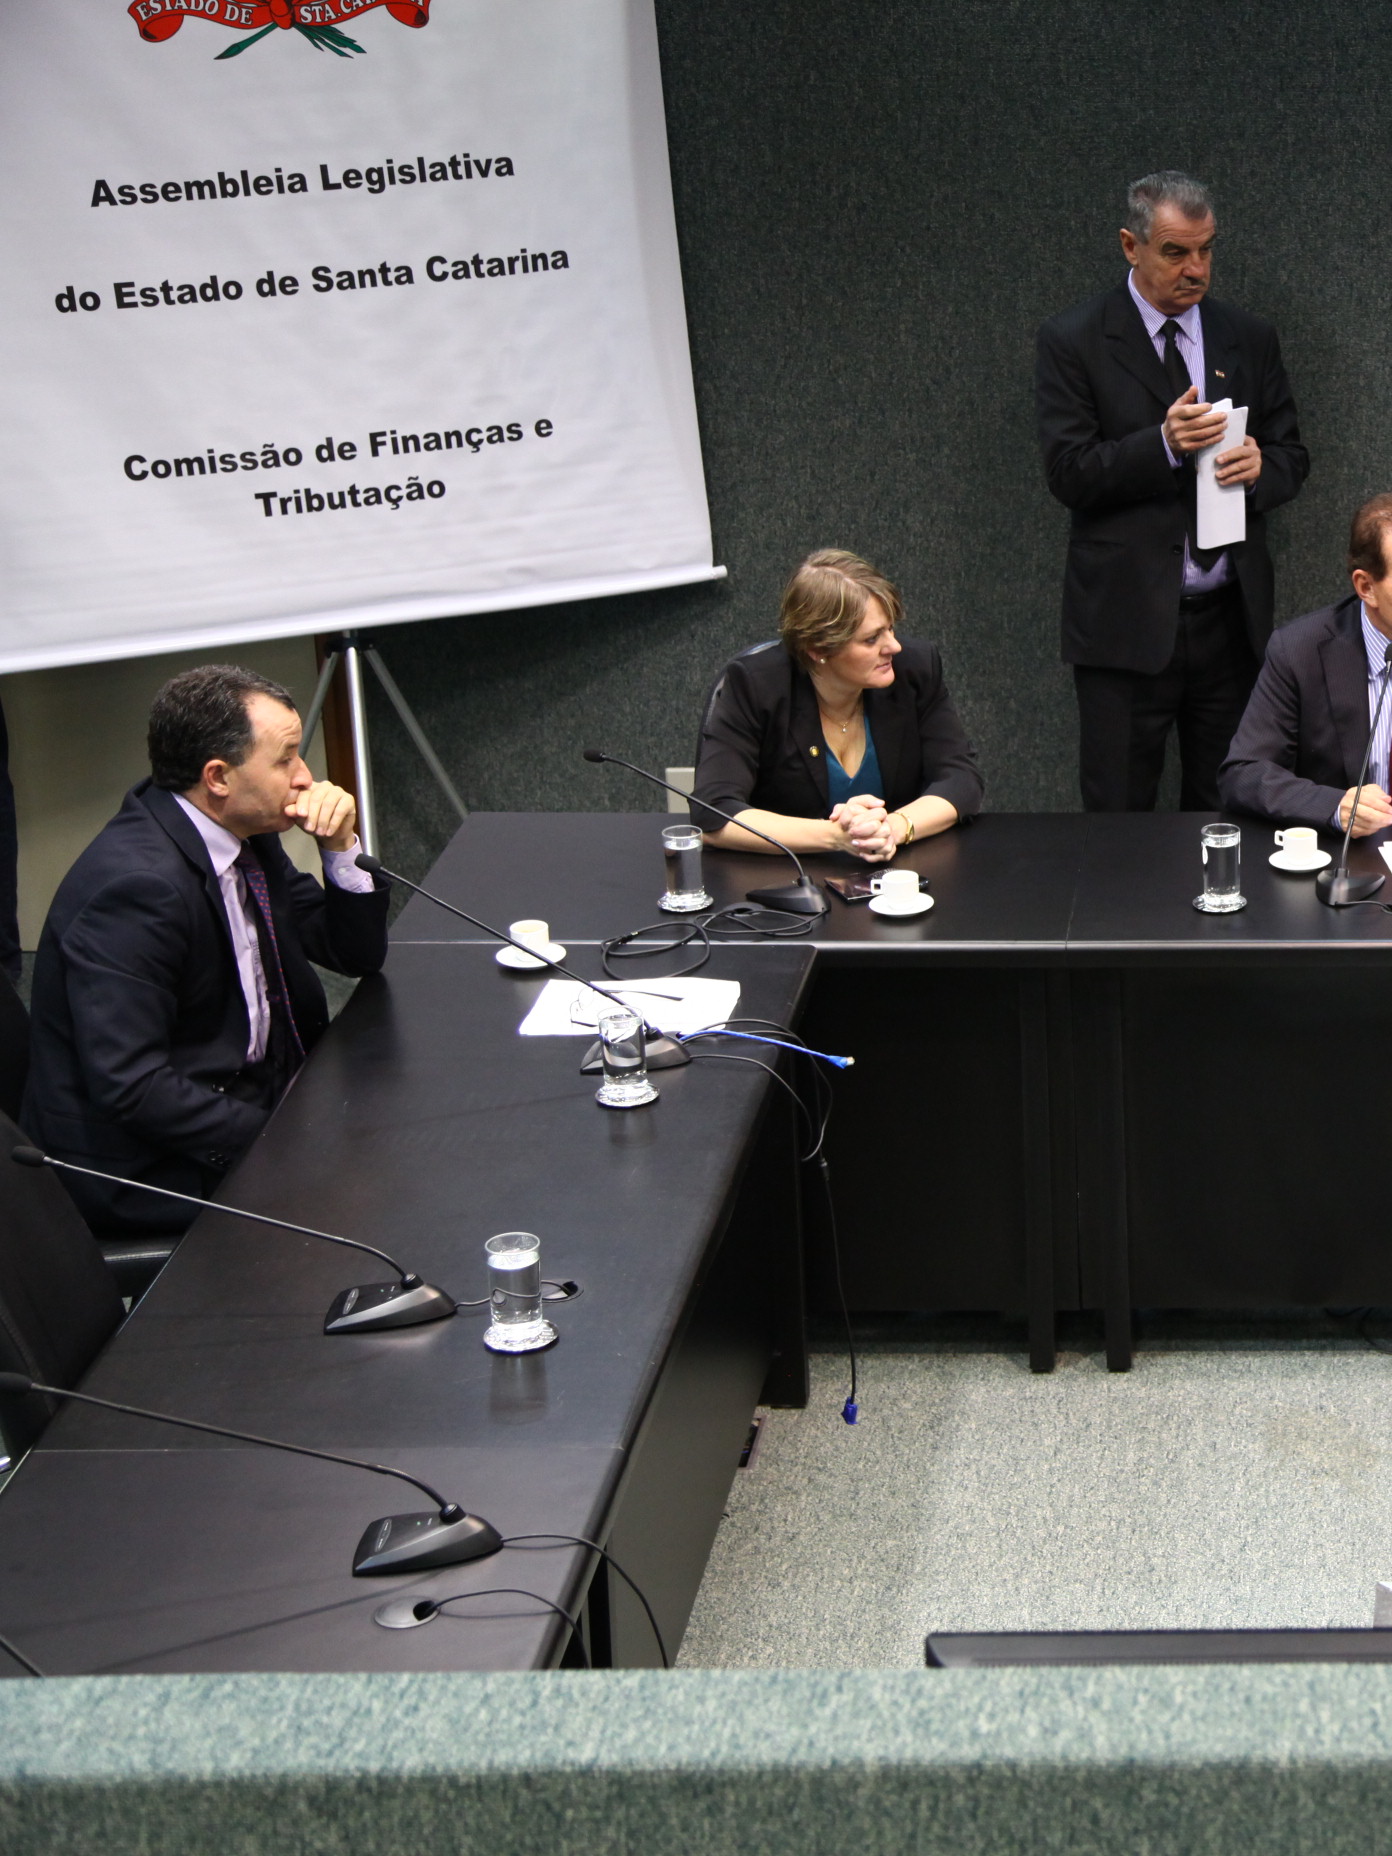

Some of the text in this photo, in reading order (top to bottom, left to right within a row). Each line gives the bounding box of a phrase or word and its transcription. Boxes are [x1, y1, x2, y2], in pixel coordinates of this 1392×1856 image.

[224, 4, 253, 25] DE
[91, 152, 515, 208] Assembleia Legislativa
[54, 248, 570, 314] do Estado de Santa Catarina
[123, 418, 553, 482] Comissão de Finanças e
[254, 475, 446, 517] Tributação
